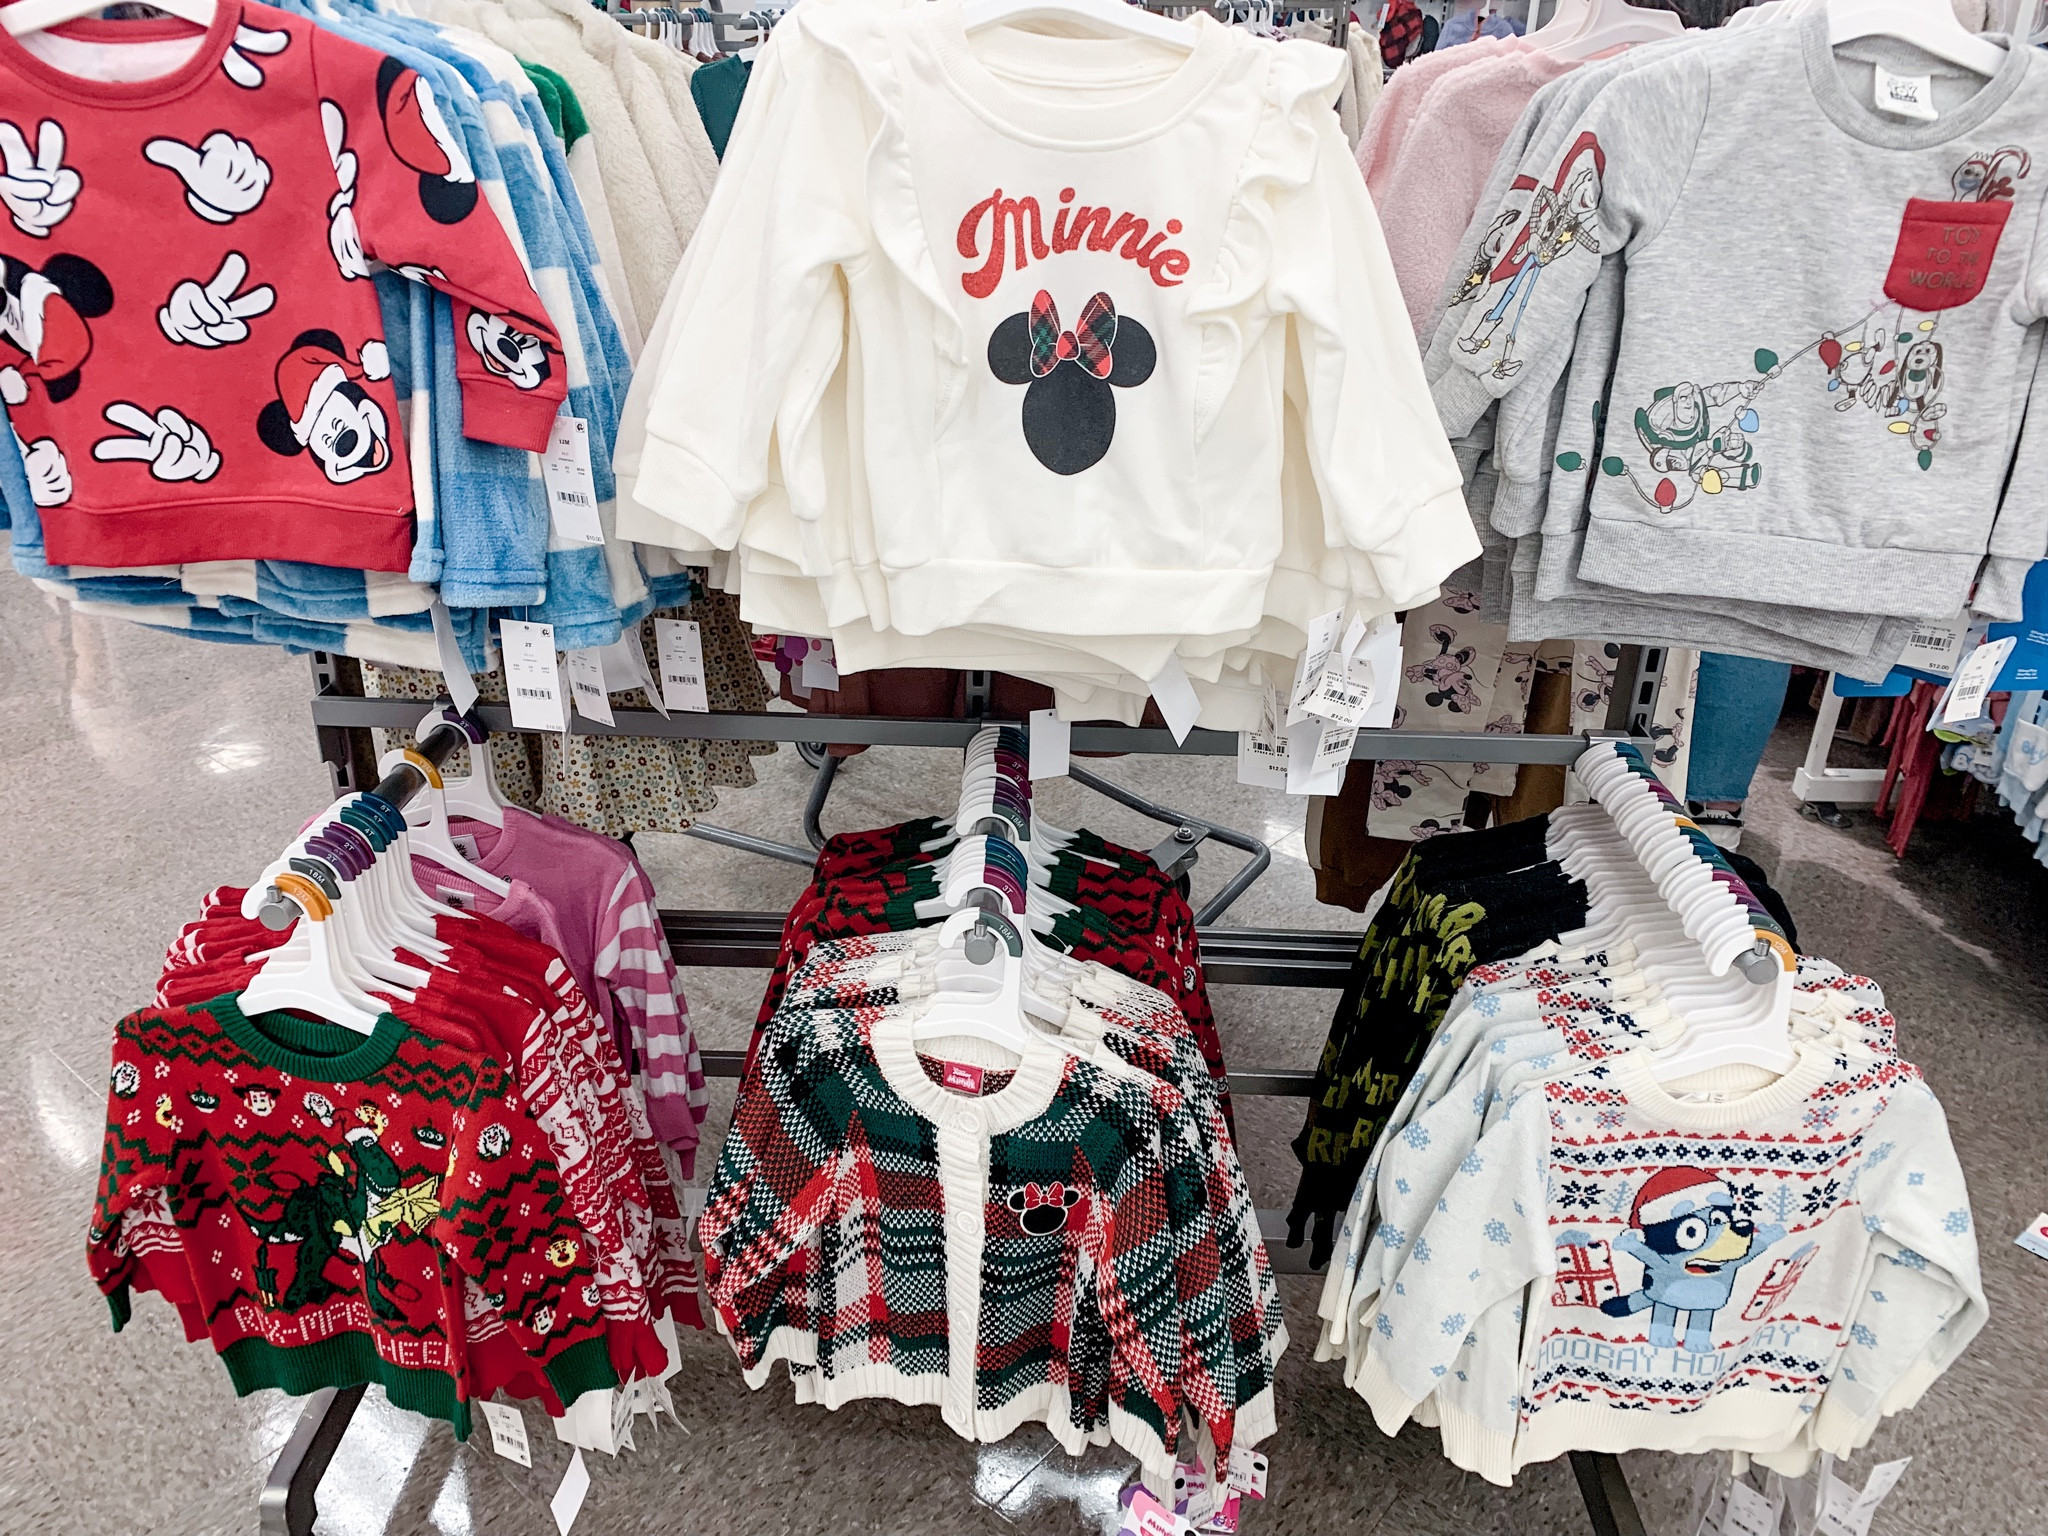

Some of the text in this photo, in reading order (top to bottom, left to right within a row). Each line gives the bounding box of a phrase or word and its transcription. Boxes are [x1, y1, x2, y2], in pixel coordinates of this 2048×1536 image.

[957, 187, 1190, 299] Minnie
[1927, 247, 1952, 265] TO
[1929, 662, 1949, 670] $12.00
[1331, 713, 1352, 723] $12.00
[460, 720, 469, 728] 2T
[1011, 761, 1022, 770] 3T
[1332, 760, 1347, 768] $12.00
[1013, 774, 1024, 783] 3T
[1010, 814, 1024, 828] 18M
[364, 828, 374, 836] 4T
[343, 842, 355, 851] 2T
[326, 853, 338, 863] 2T
[308, 869, 326, 884] 18M
[1002, 884, 1014, 894] 3T
[292, 887, 309, 904] 12M
[998, 924, 1014, 941] 18M
[1774, 940, 1789, 955] 12M
[1537, 1337, 1658, 1374] HOORAY
